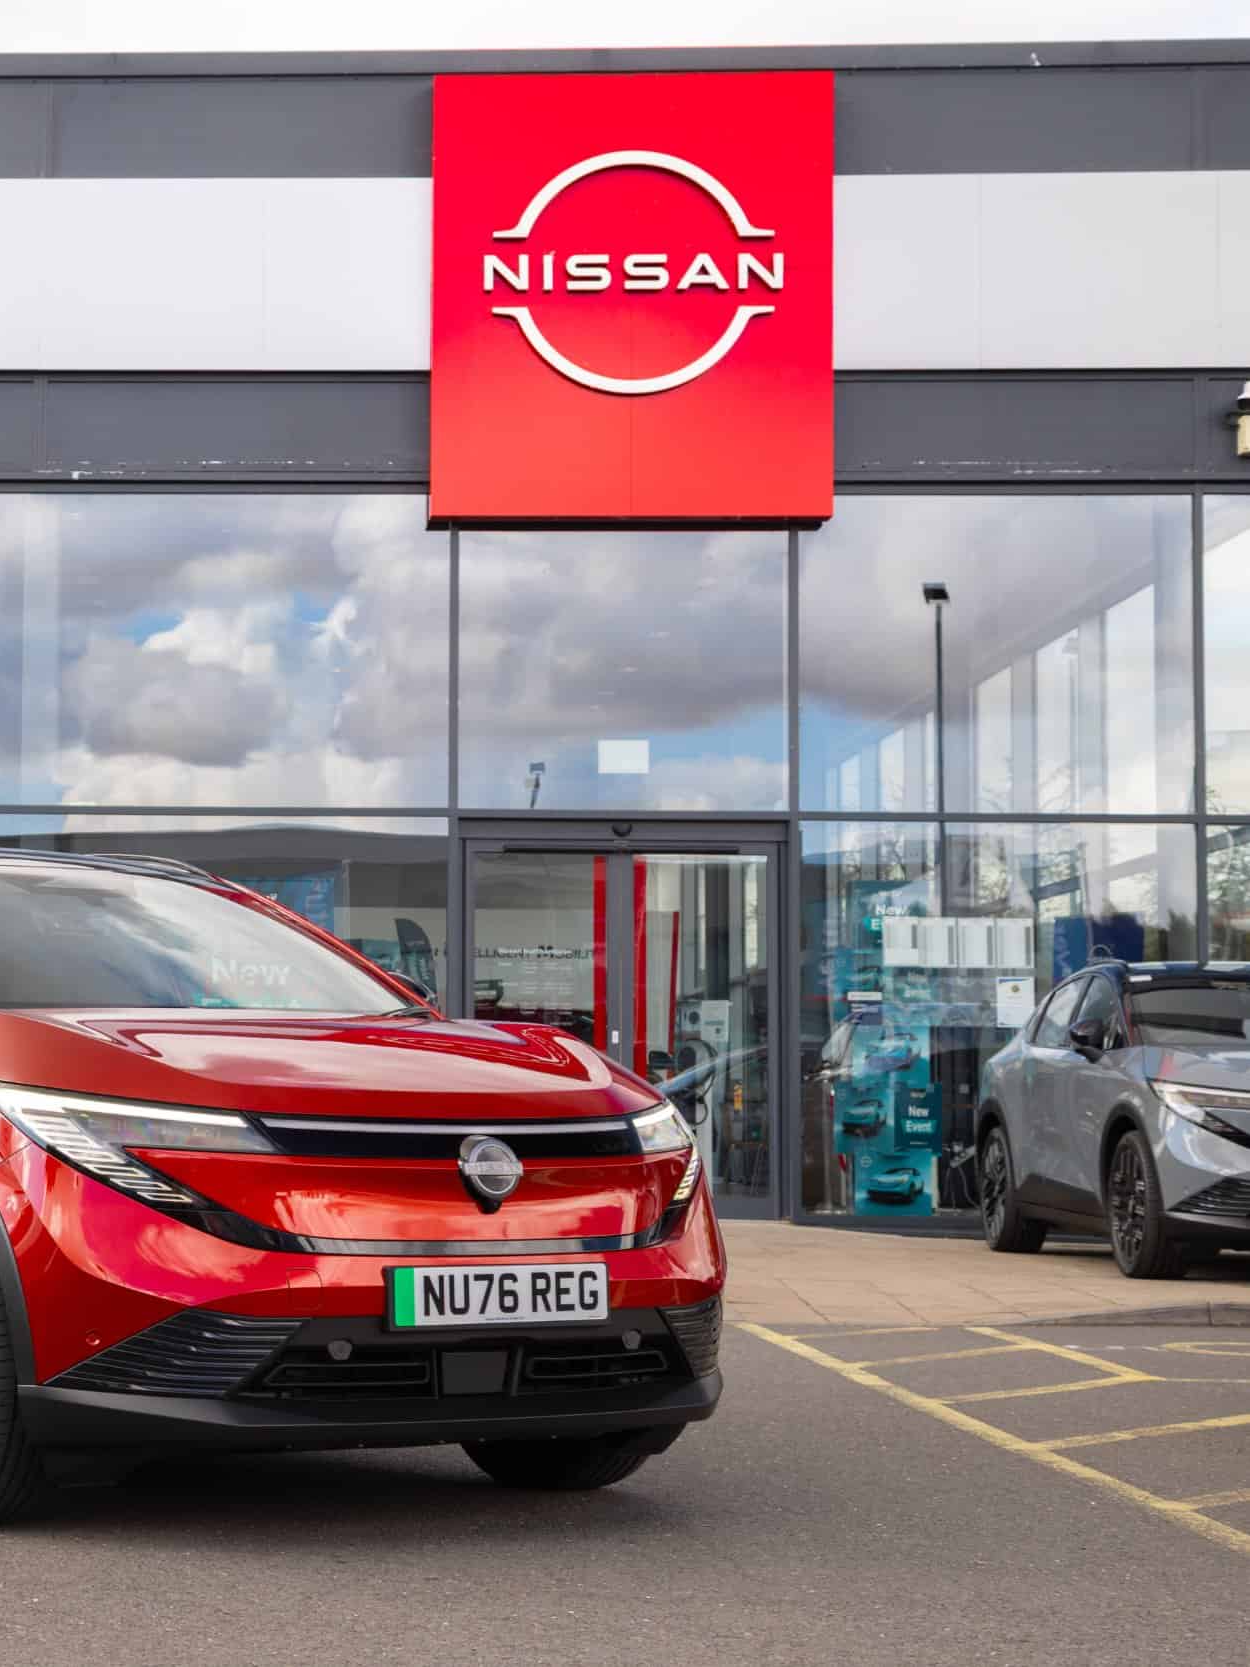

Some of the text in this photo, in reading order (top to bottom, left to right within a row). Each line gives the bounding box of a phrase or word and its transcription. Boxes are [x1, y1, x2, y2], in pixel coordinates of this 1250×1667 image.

[482, 251, 785, 292] NISSAN
[211, 956, 292, 986] New
[422, 1270, 599, 1317] NU76 REG
